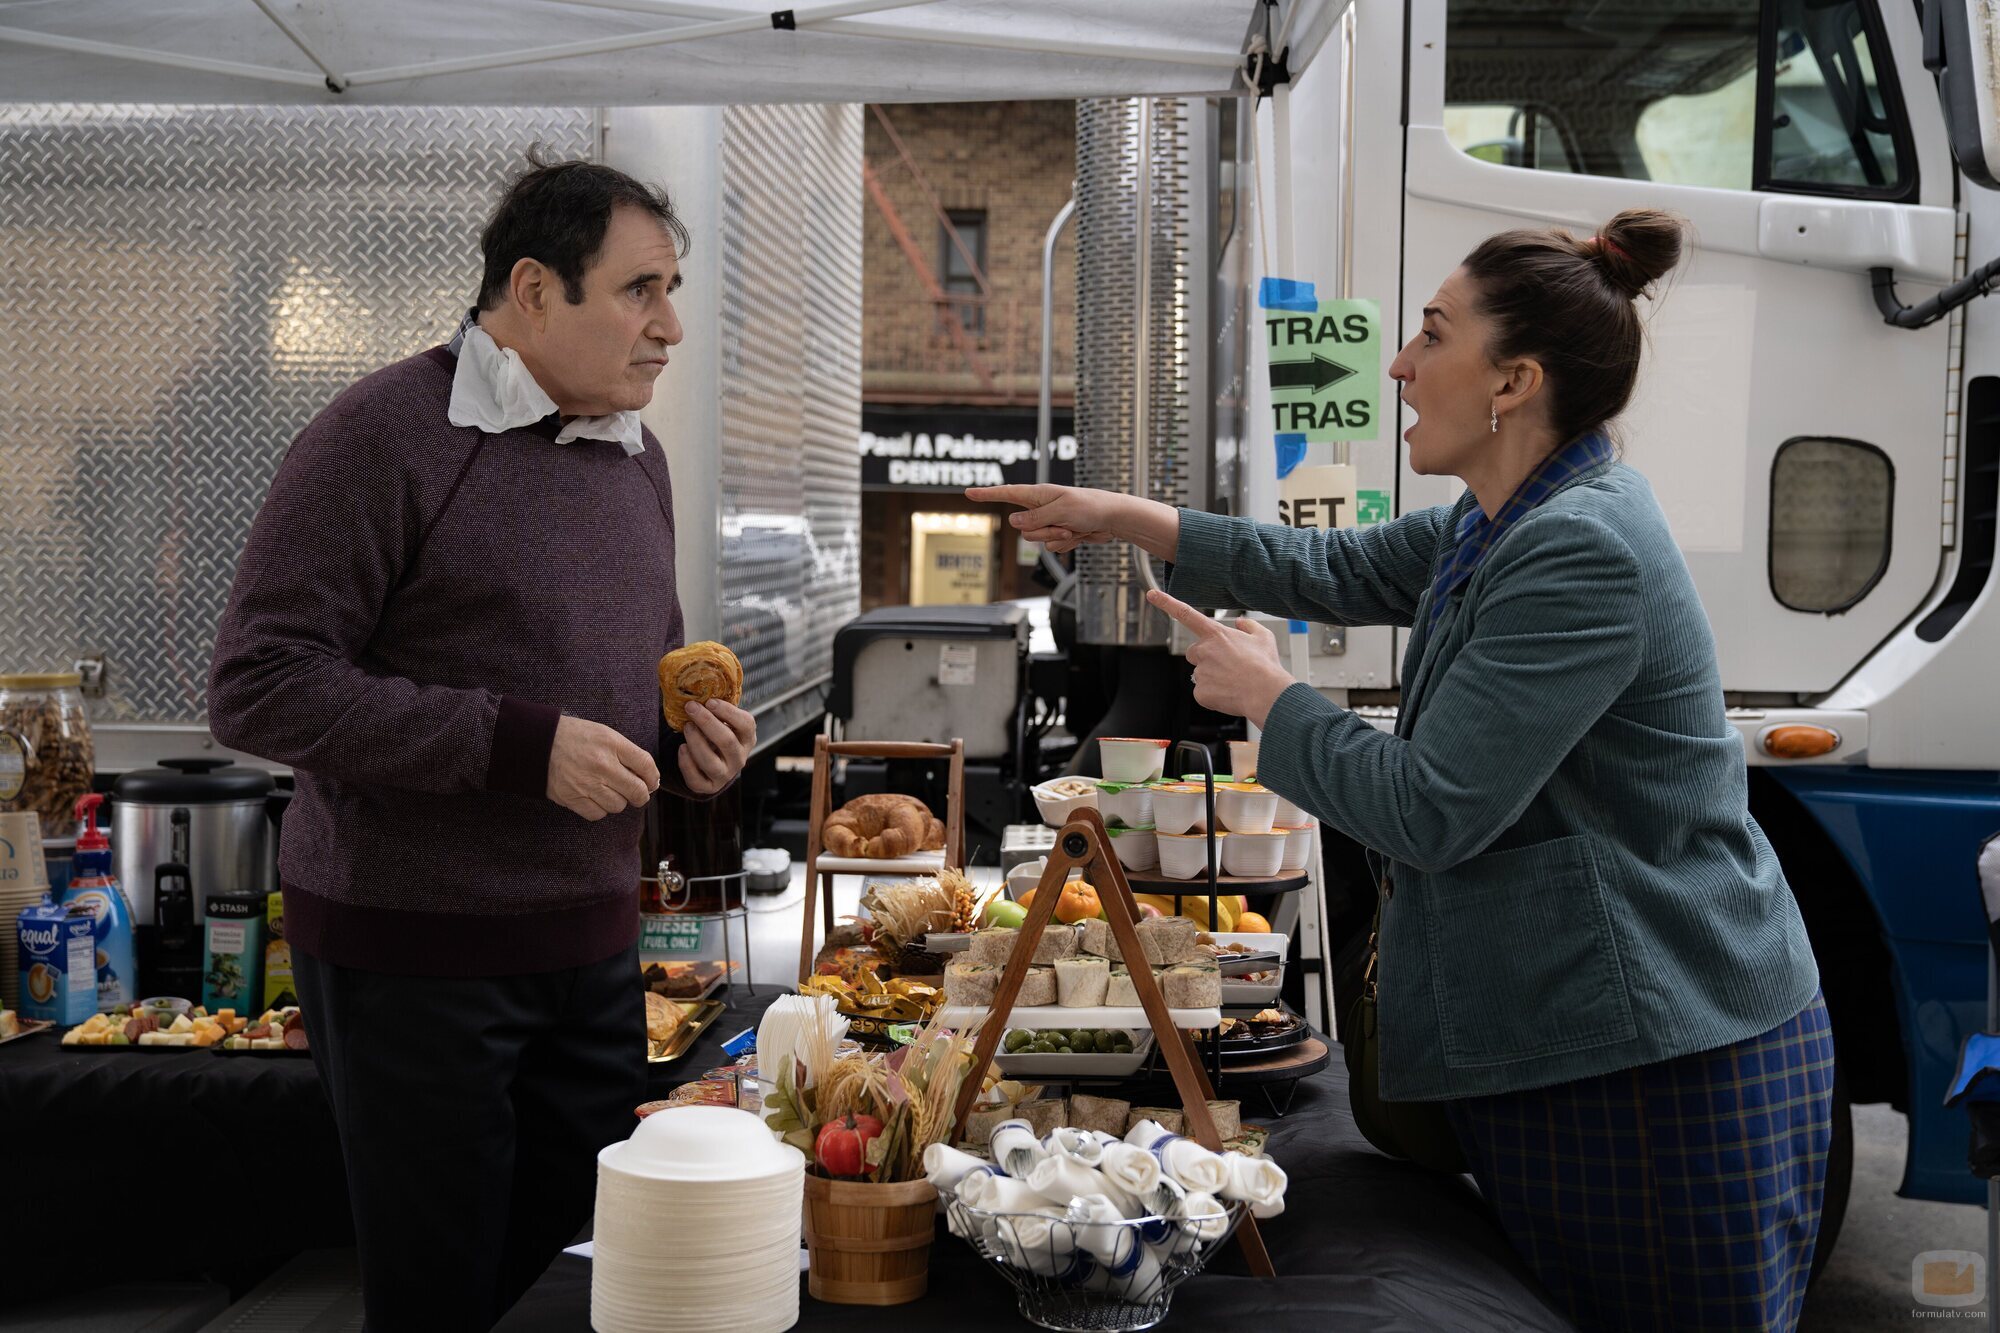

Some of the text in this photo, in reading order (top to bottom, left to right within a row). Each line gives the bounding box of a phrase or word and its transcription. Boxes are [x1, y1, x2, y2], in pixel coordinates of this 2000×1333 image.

[1266, 314, 1369, 346] TRAS
[1272, 399, 1370, 431] TRAS
[859, 431, 912, 457] Paul
[913, 433, 934, 458] A
[888, 460, 1005, 485] DENTISTA
[1278, 497, 1345, 528] SET
[220, 903, 248, 913] STASH
[21, 923, 59, 950] equal
[646, 916, 699, 933] DIESEL
[643, 936, 698, 949] FUEL ONLY
